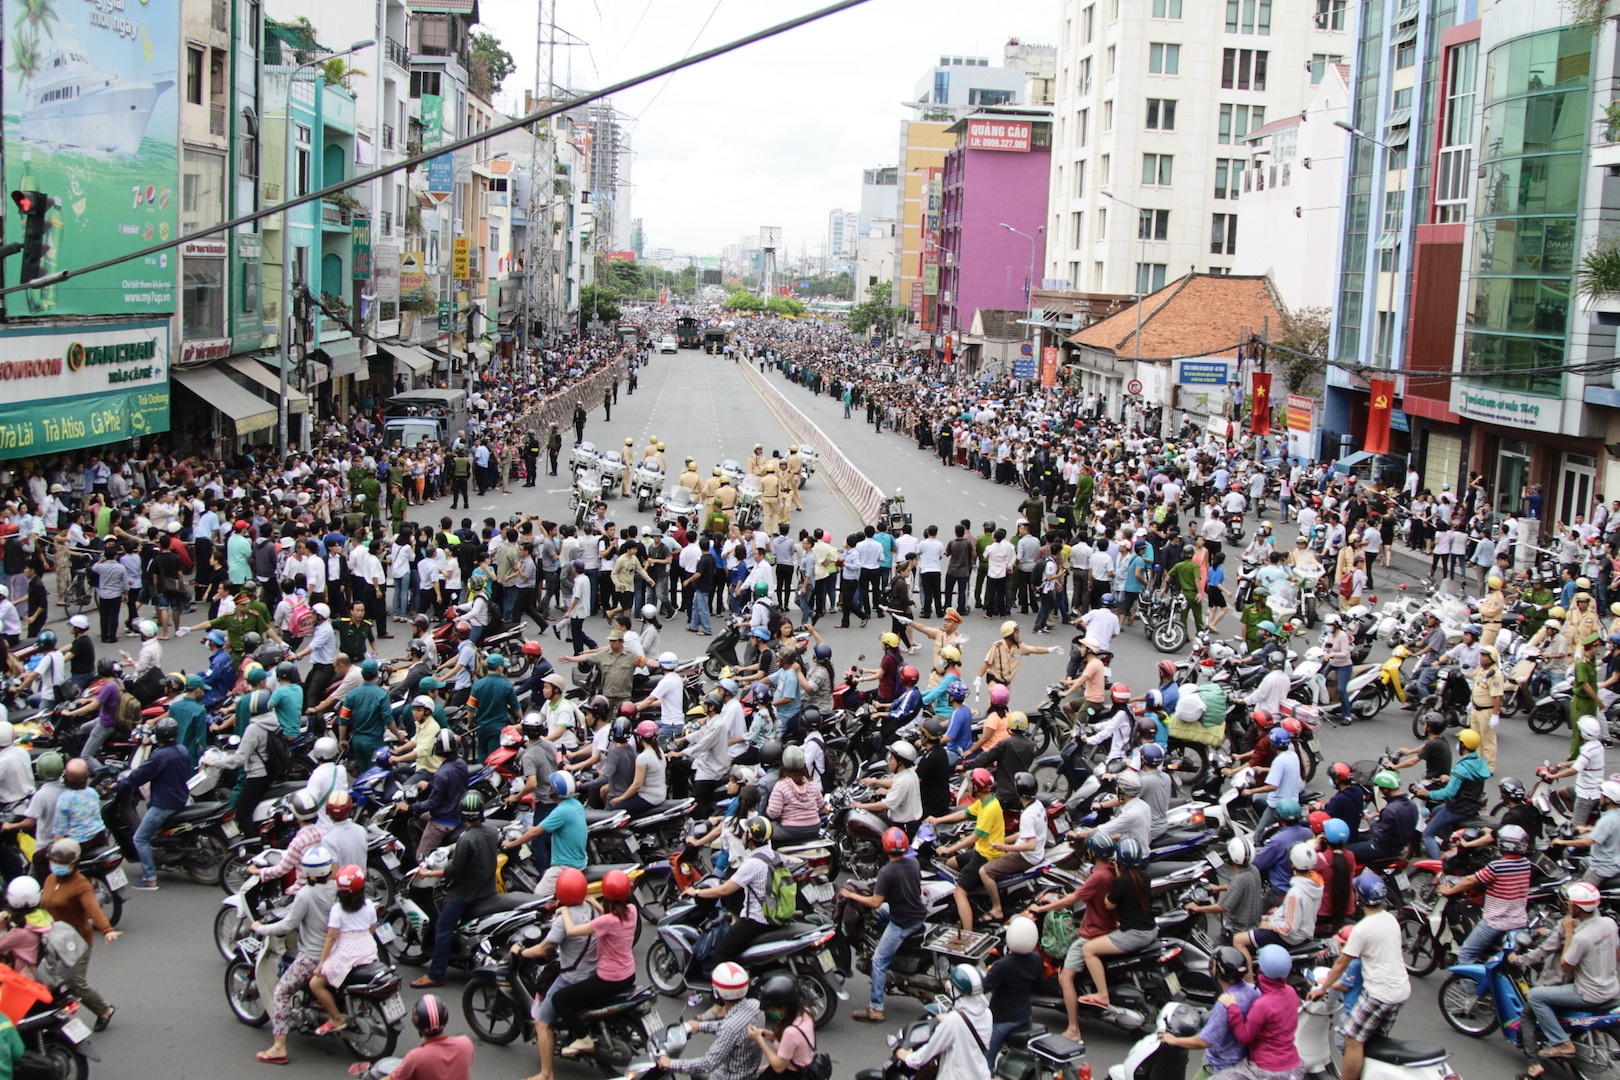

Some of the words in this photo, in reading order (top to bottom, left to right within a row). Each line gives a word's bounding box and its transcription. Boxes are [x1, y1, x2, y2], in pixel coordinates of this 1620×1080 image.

[971, 121, 1005, 137] QUẢNG
[1007, 124, 1028, 138] CÁO
[124, 291, 171, 305] www.my7up.vn
[0, 424, 17, 449] Trà
[18, 421, 34, 447] Lài
[43, 418, 60, 442] Trà
[91, 412, 104, 435] Cà
